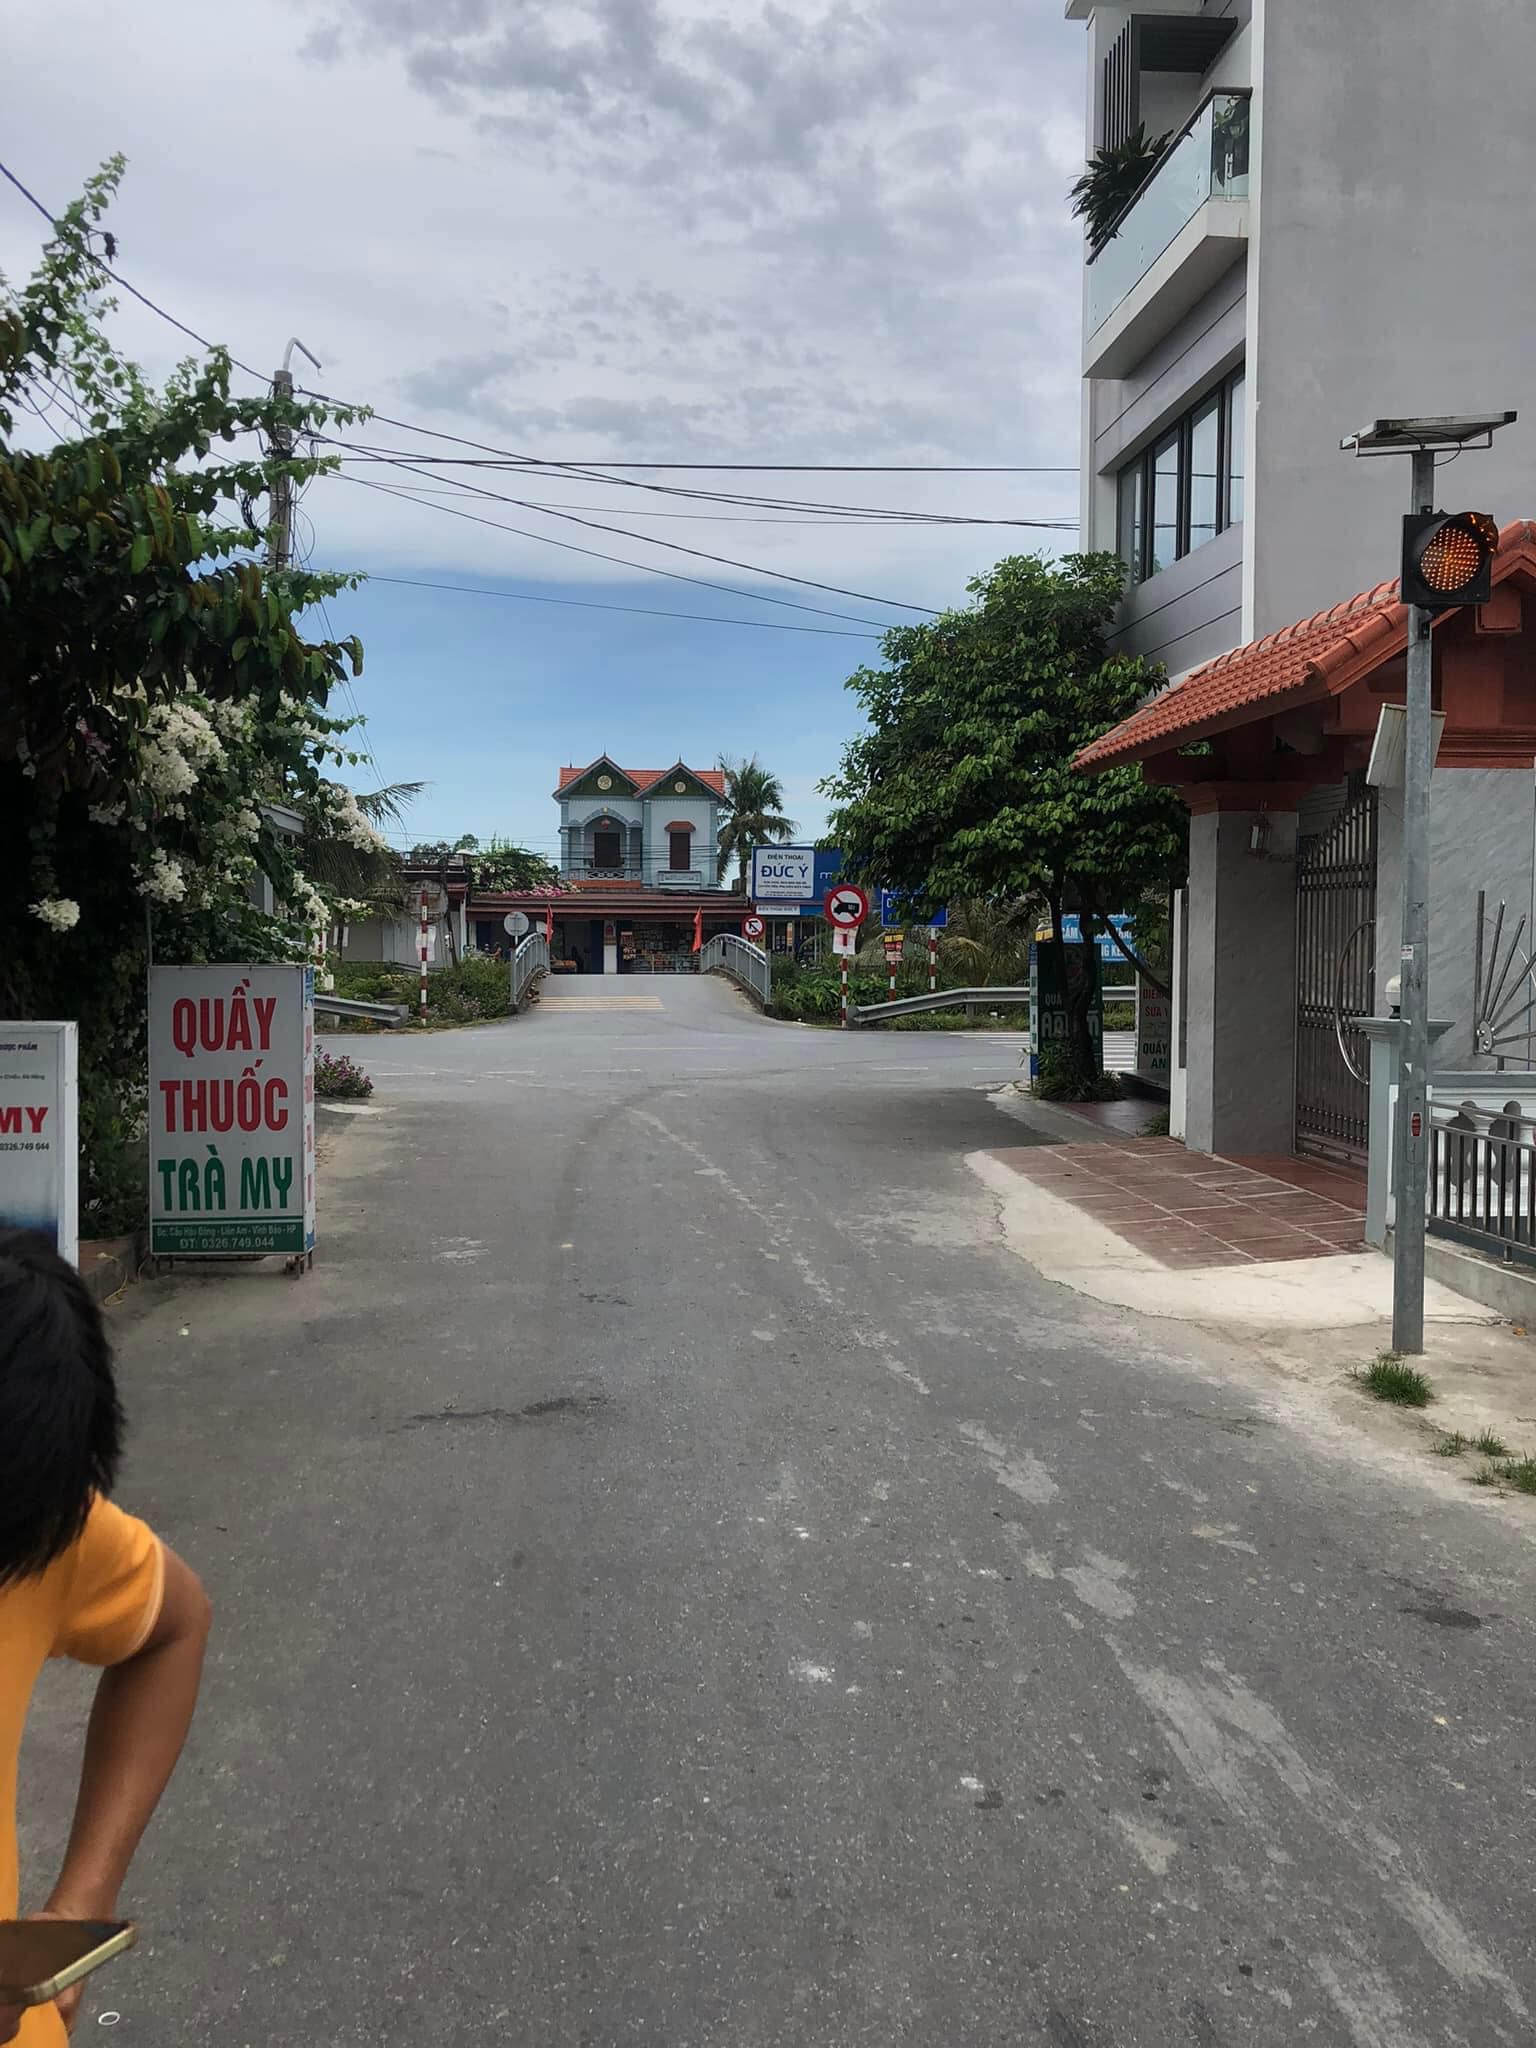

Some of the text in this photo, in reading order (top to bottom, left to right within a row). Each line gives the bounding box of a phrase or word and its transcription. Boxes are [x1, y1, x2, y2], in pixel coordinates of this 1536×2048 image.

[761, 863, 794, 878] ĐỨC
[798, 863, 809, 878] Ý
[172, 979, 277, 1058] QUẦY
[0, 1106, 48, 1133] MY
[159, 1059, 289, 1133] THUỐC
[158, 1144, 293, 1211] TRÀ MY
[202, 1237, 274, 1249] 0326.749.044
